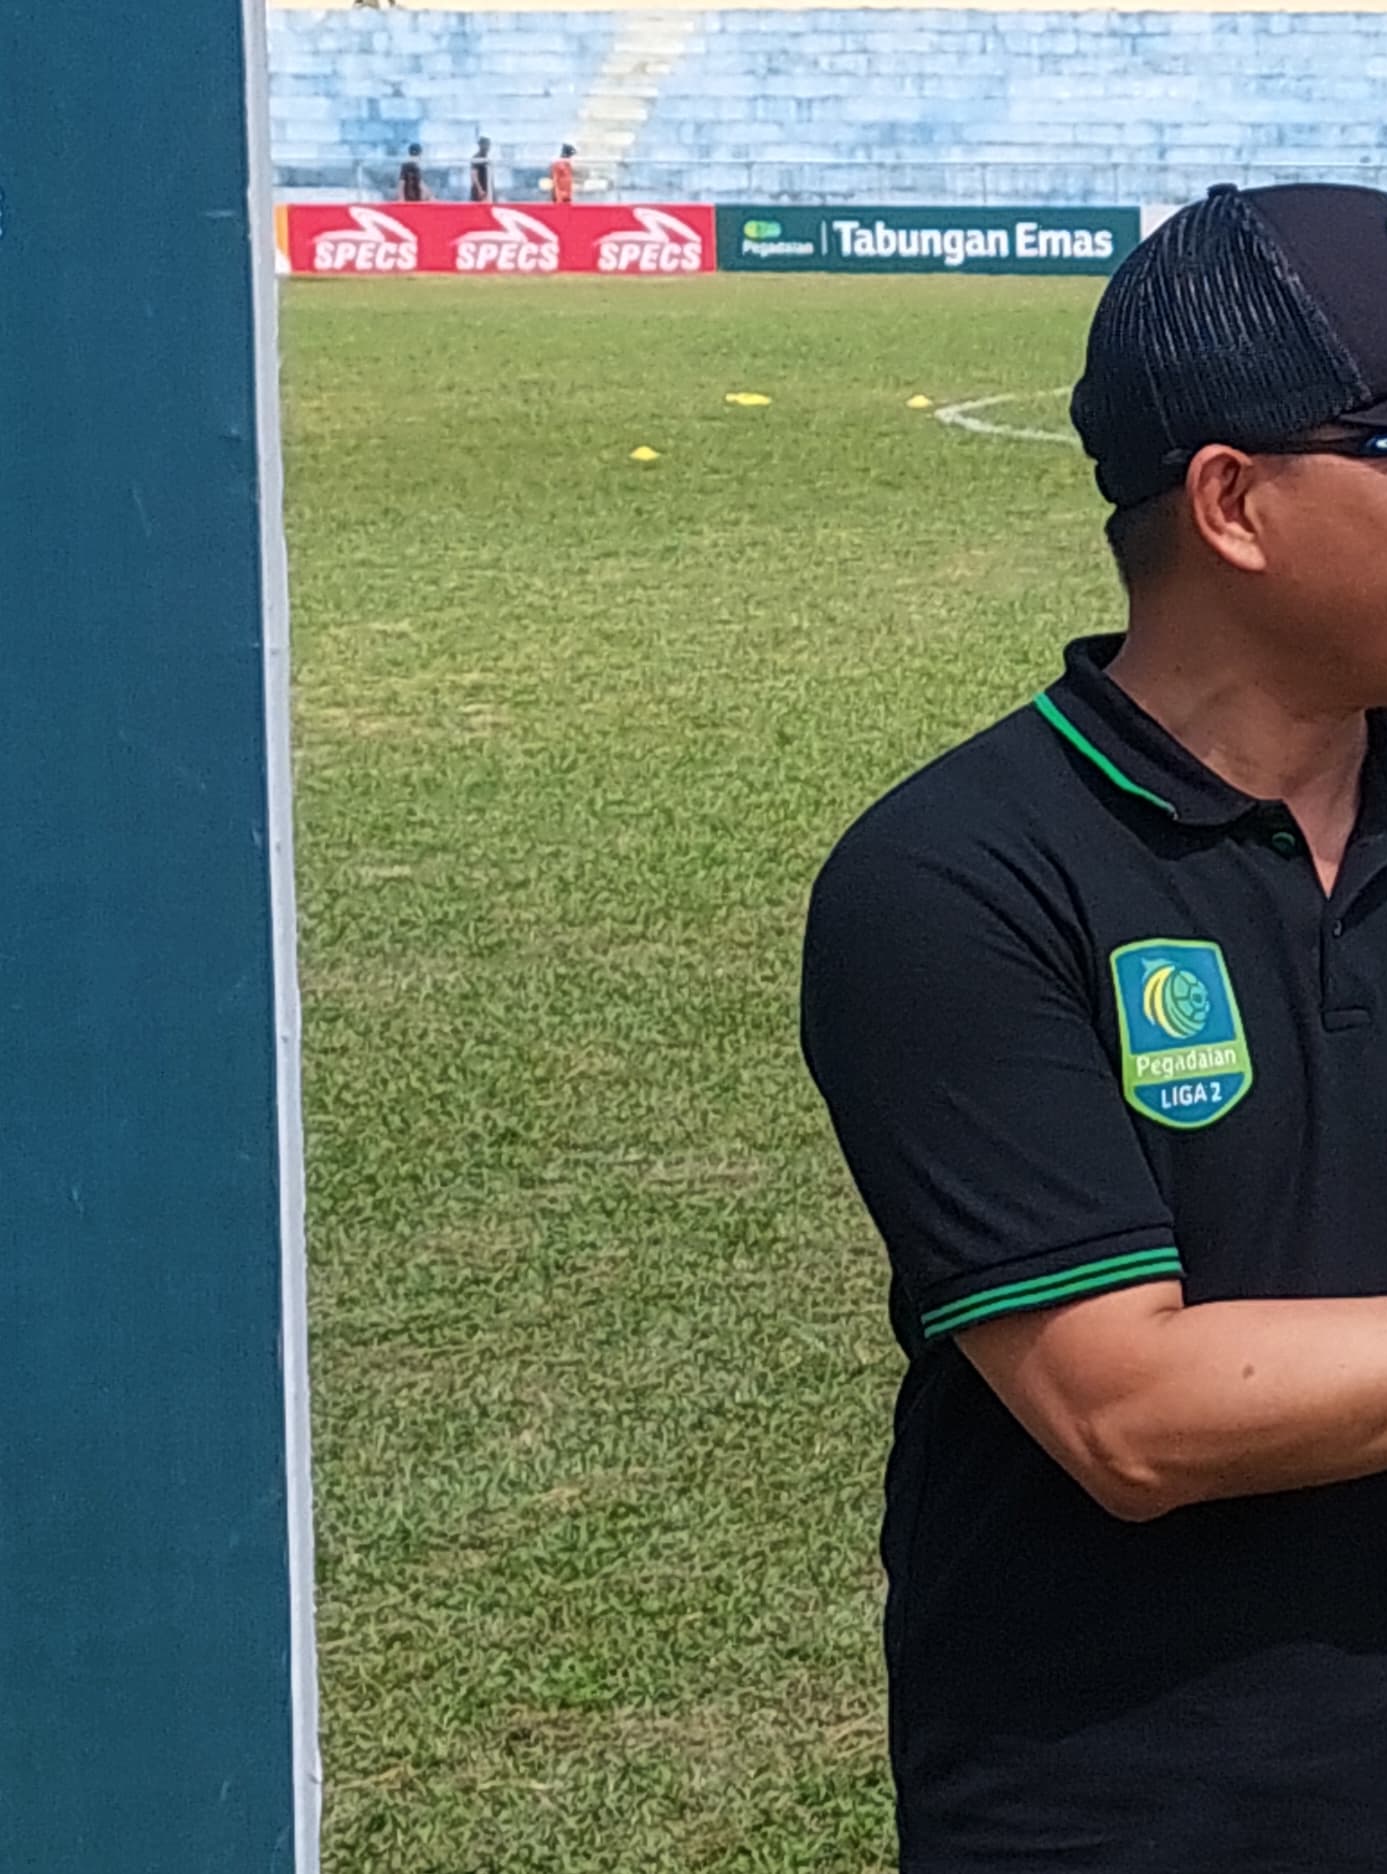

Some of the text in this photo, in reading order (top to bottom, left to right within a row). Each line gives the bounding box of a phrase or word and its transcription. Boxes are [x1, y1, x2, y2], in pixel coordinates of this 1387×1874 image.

[314, 241, 417, 270] SPECS
[455, 241, 559, 270] SPECS
[597, 241, 702, 270] SPECS
[833, 220, 1113, 266] Tabungan Emas
[1136, 1047, 1236, 1077] Pegadaian
[1160, 1081, 1222, 1109] LIGA 2
